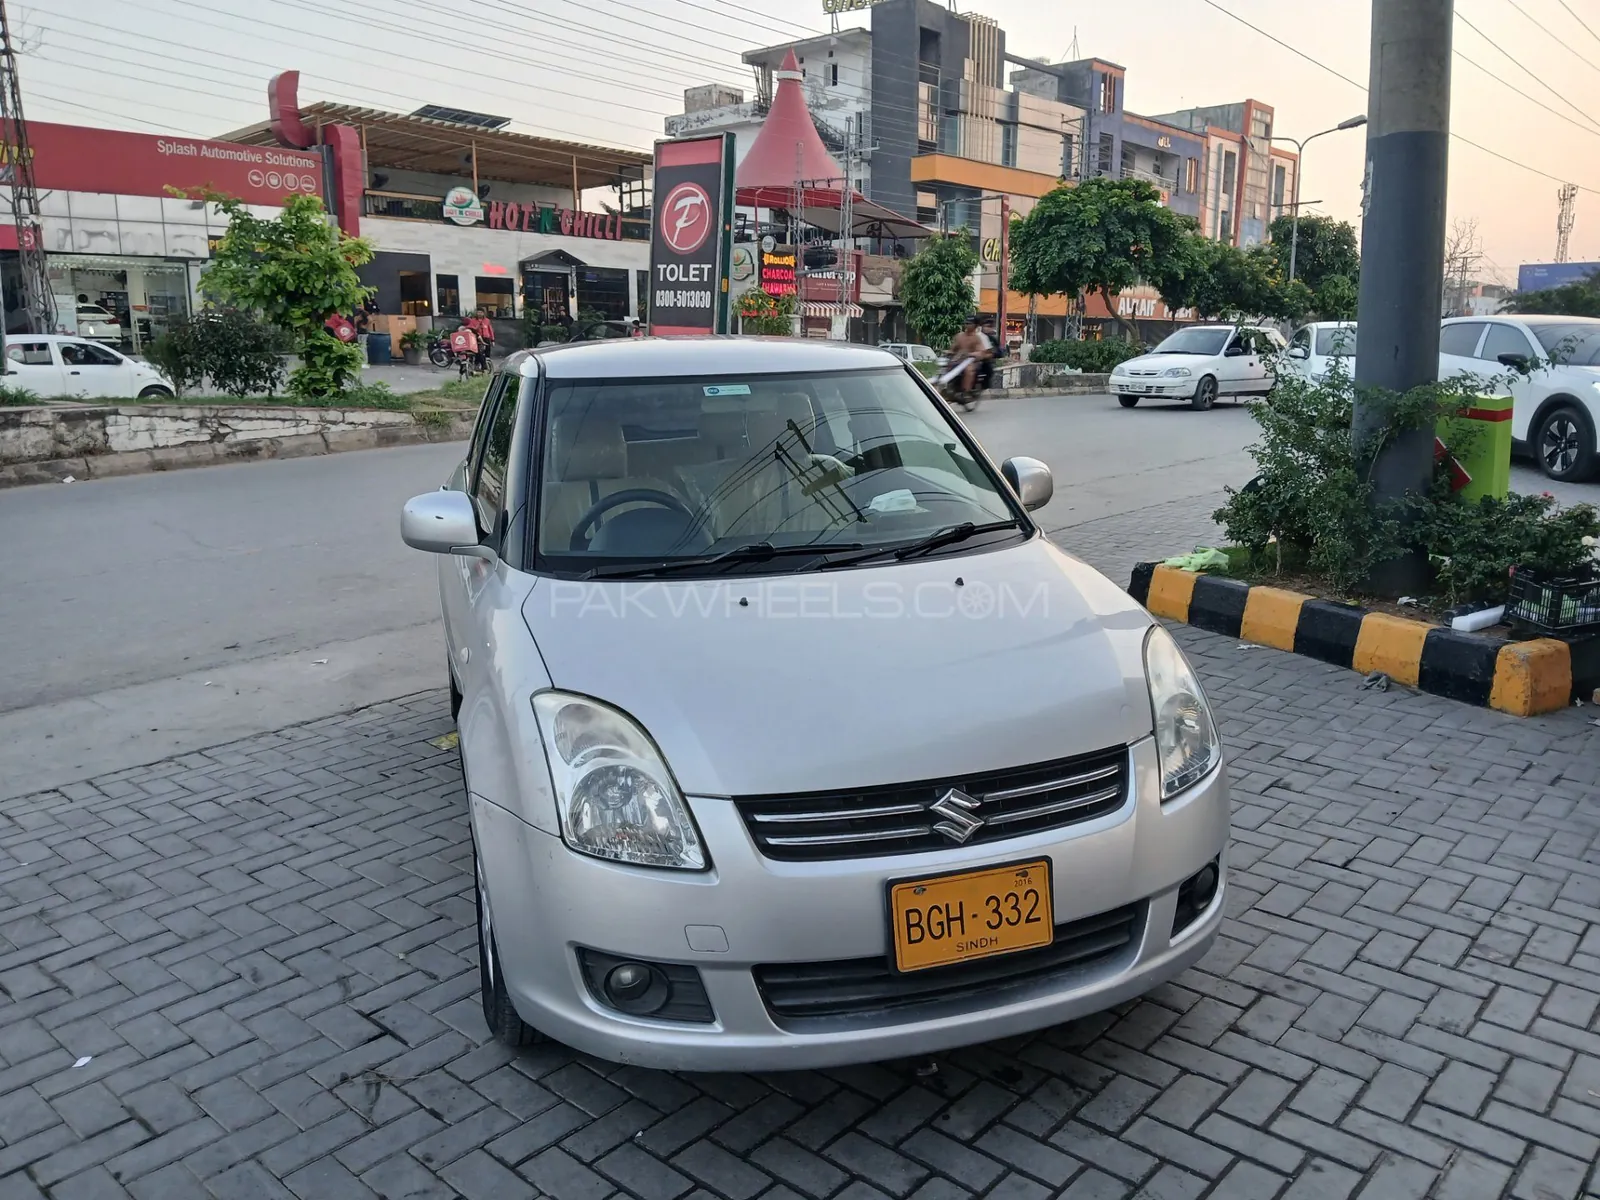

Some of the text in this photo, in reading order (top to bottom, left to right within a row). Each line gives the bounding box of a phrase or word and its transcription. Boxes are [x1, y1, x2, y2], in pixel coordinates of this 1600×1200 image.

[157, 139, 316, 169] Splash Automotive Solutions
[489, 200, 622, 241] HOT N CHILLI
[657, 263, 712, 282] TOLET
[762, 268, 796, 281] CHARCOAL
[655, 290, 711, 308] 0300-5013030
[1014, 877, 1033, 888] 2016
[956, 936, 999, 953] SINDH
